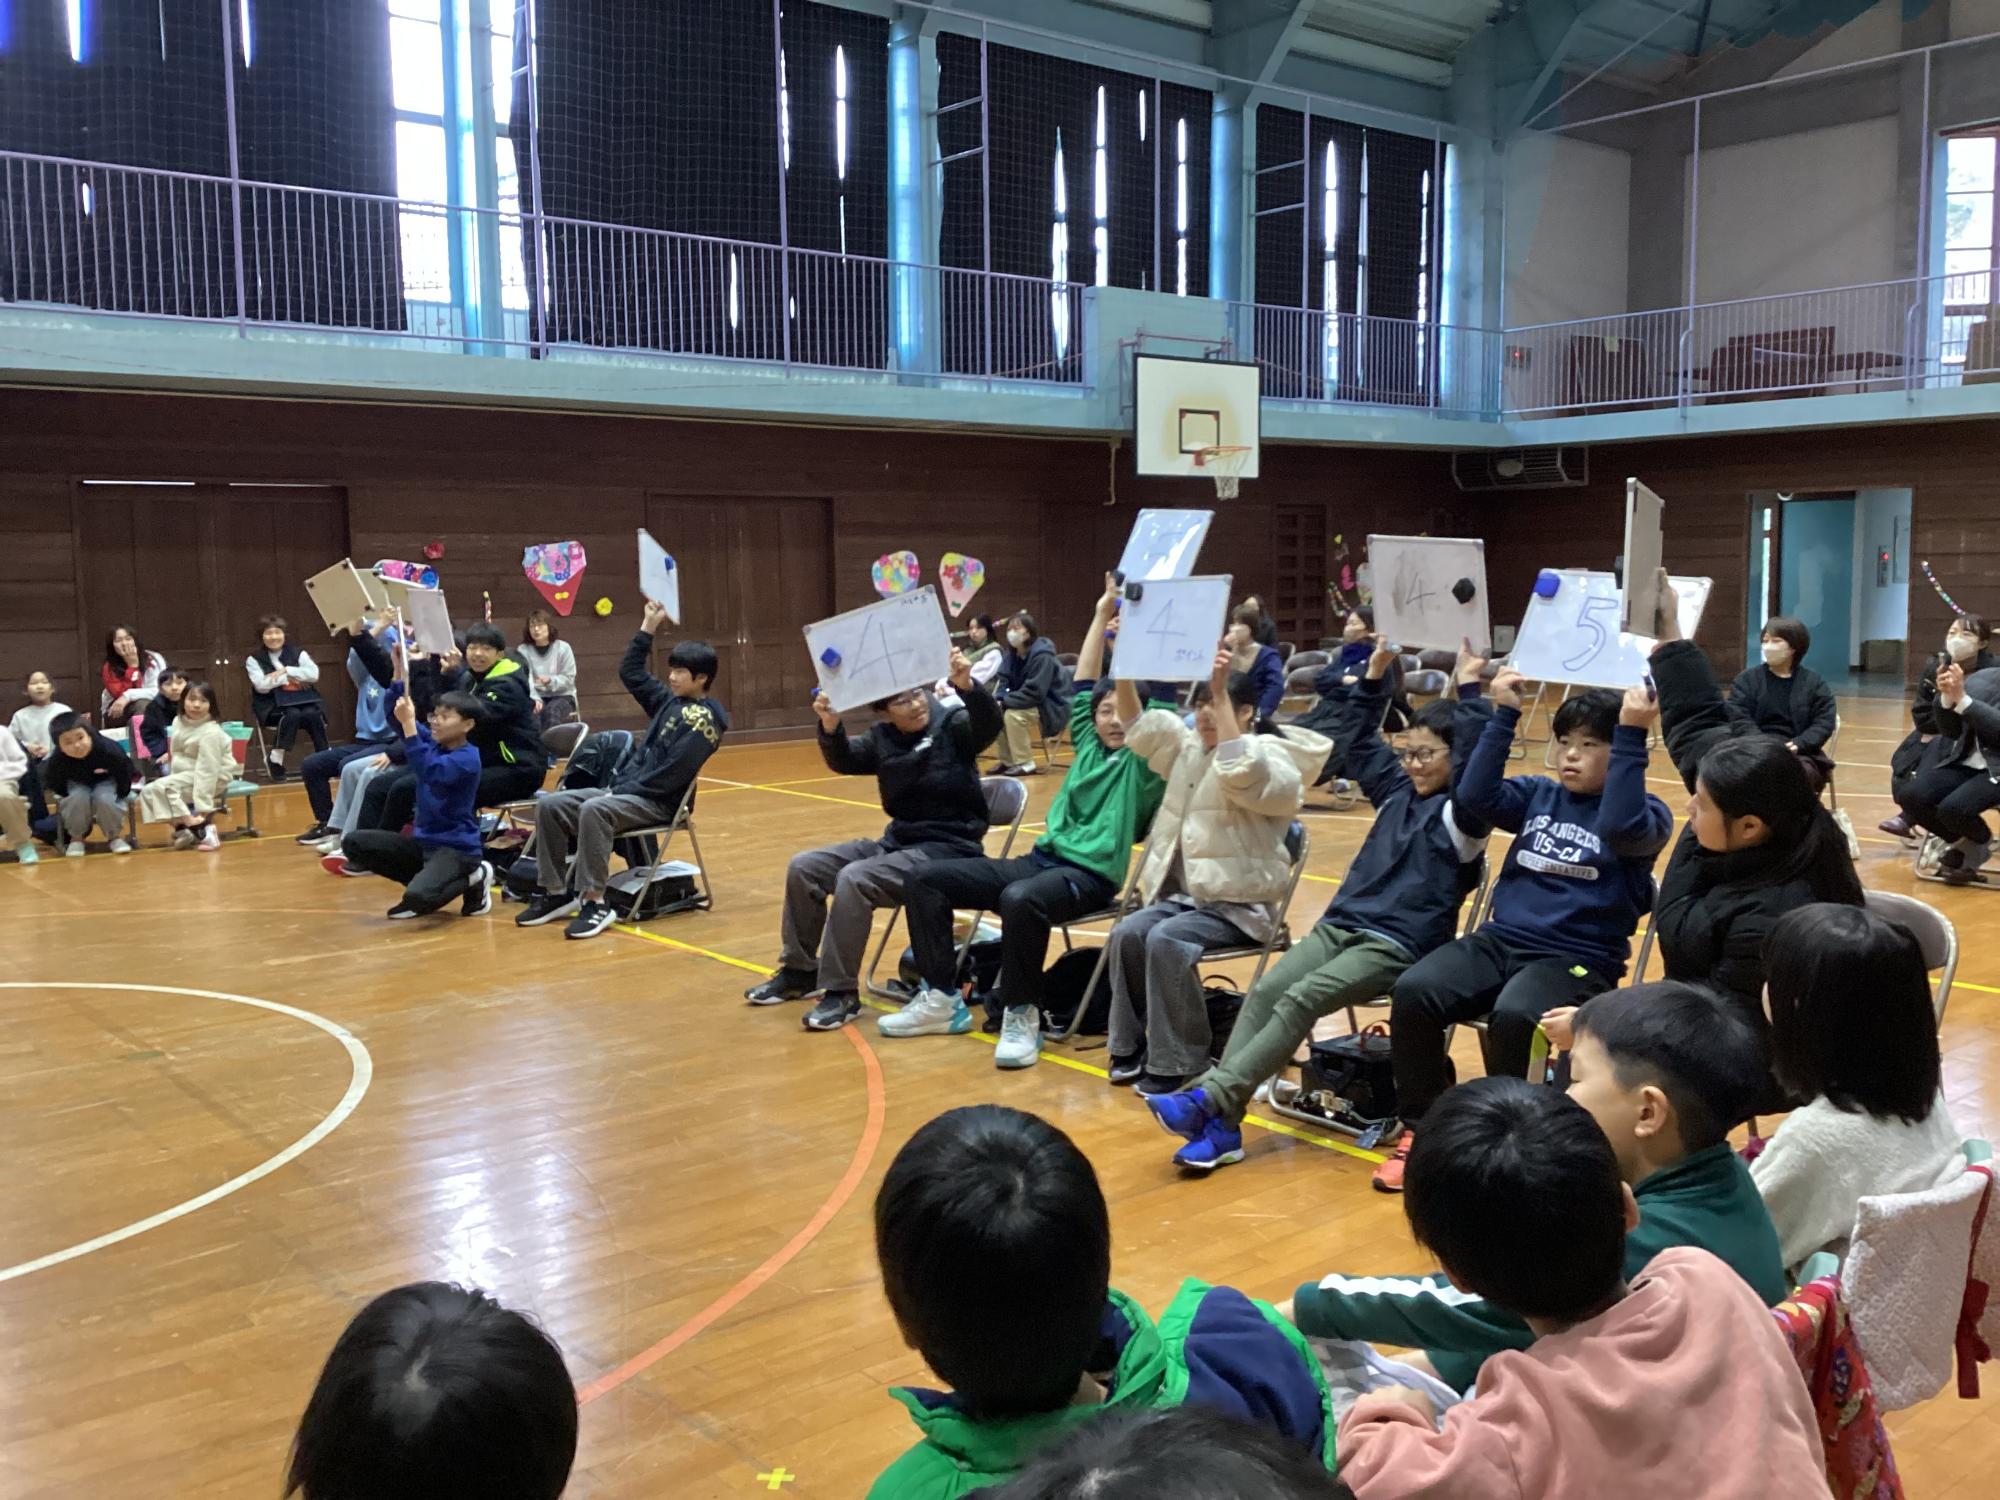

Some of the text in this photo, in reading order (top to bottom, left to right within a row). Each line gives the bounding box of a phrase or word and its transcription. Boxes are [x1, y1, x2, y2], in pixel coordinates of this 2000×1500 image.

[1406, 571, 1436, 616] 4
[848, 613, 914, 688] 4
[1145, 597, 1188, 660] 4
[1562, 596, 1619, 672] 5
[1522, 815, 1551, 837] LOS
[1532, 831, 1583, 863] US-CA
